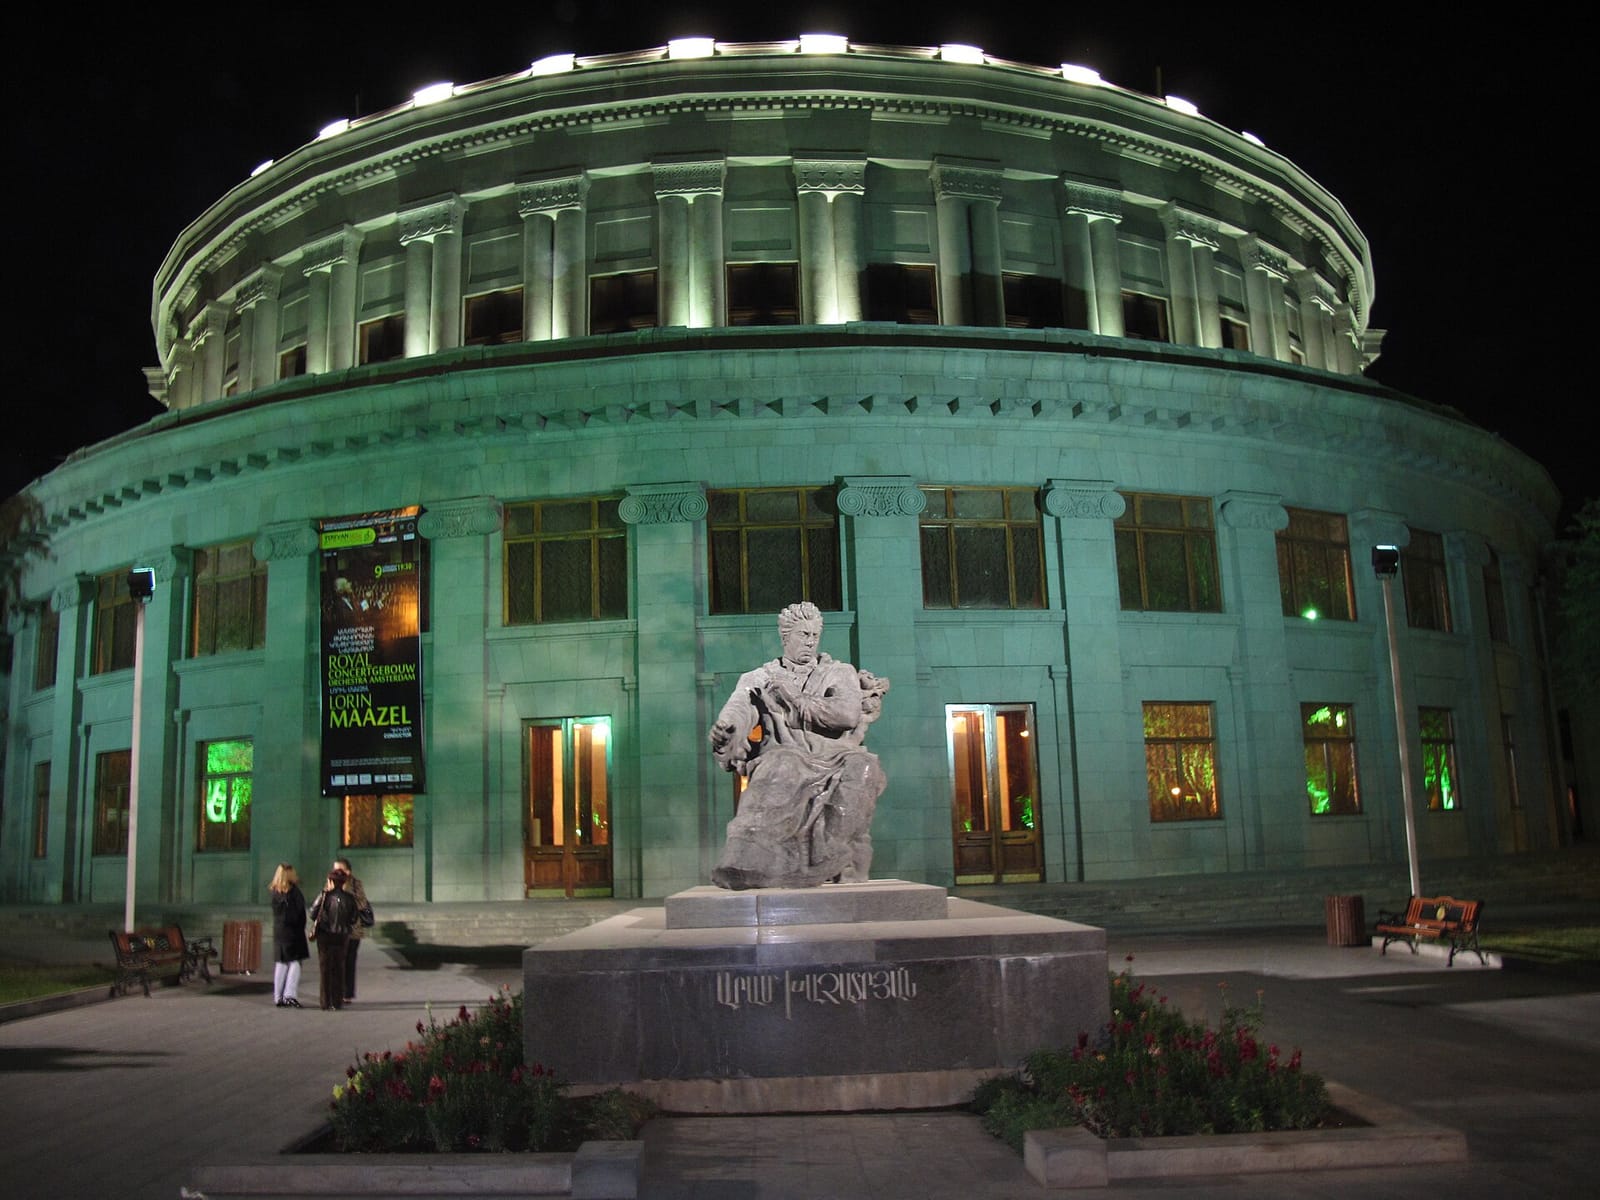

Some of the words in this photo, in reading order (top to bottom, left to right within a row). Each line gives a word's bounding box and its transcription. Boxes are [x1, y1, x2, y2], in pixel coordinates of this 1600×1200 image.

[374, 565, 383, 579] 9
[328, 652, 370, 670] ROYAL
[328, 664, 416, 680] CONCERTGEBOUW
[328, 677, 368, 687] ORCHESTRA
[370, 673, 416, 684] AMSTERDAM
[329, 693, 372, 710] LORIN
[329, 705, 412, 729] MAAZEL
